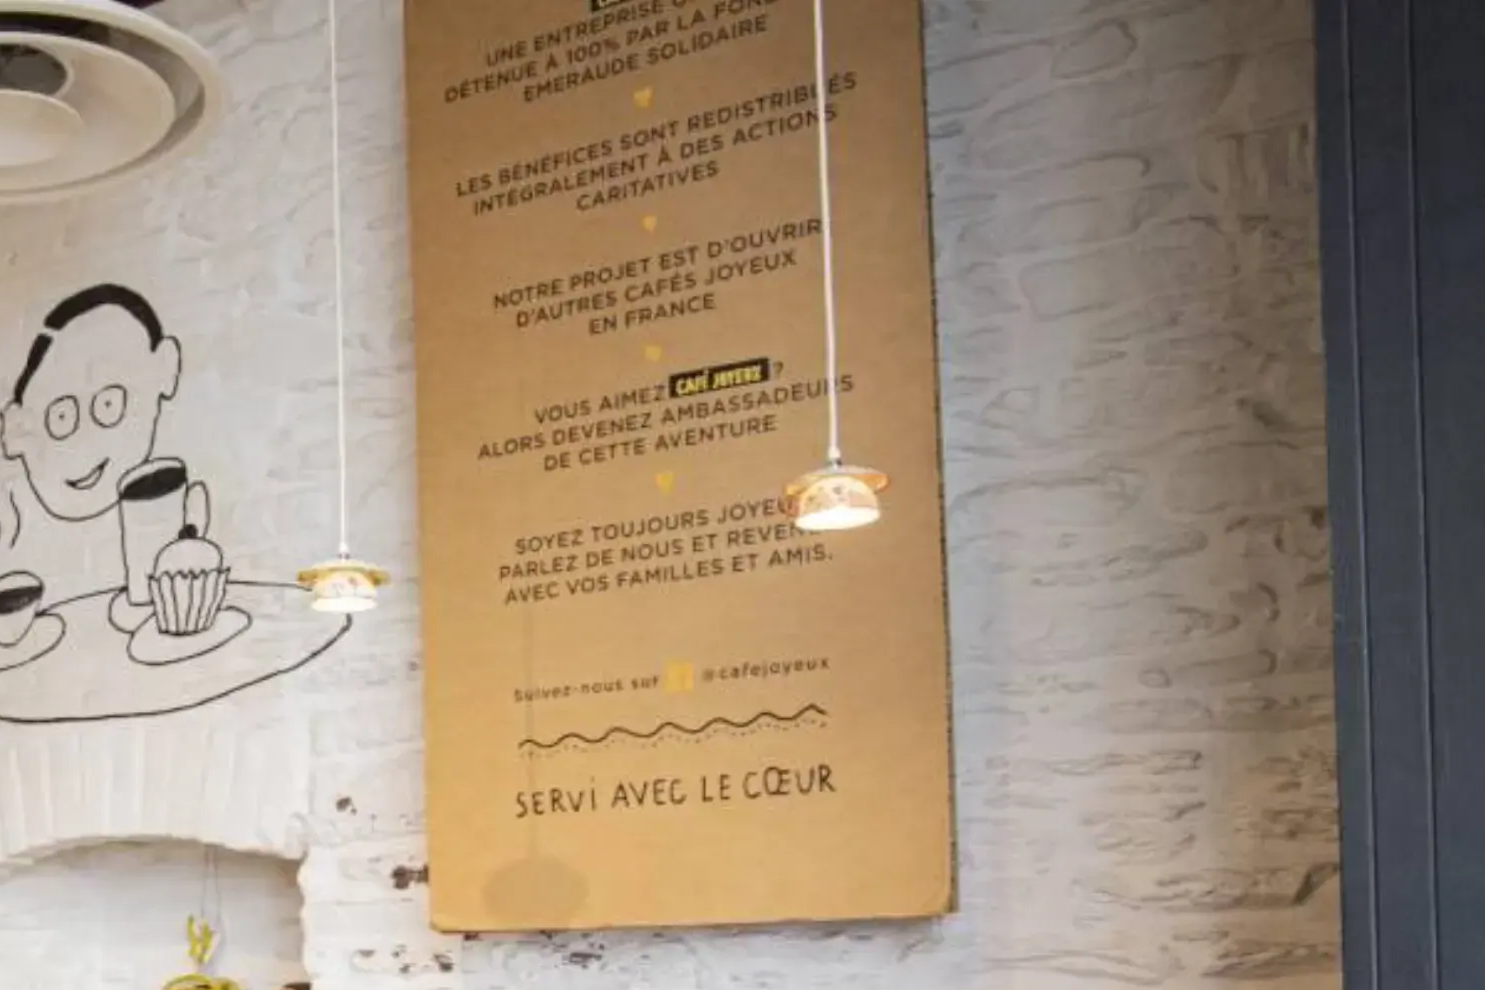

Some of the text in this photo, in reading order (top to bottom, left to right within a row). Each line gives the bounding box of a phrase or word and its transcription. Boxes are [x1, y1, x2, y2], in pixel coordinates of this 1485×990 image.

[487, 0, 665, 67] UNE ENTREPRISE
[626, 20, 670, 46] PAR
[677, 9, 706, 34] LA
[647, 14, 768, 65] SOLIDAIRE
[456, 173, 492, 197] LES
[620, 120, 679, 151] SONT
[680, 134, 724, 160] DES
[733, 103, 838, 145] ACTIONS
[576, 160, 719, 211] CARITATIVES
[493, 279, 564, 309] NOTRE
[570, 257, 651, 291] PROJET
[659, 245, 699, 271] EST
[624, 271, 696, 303] CAFÉS
[705, 248, 797, 286] JOYEUX
[589, 293, 715, 336] EN FRANCE
[534, 400, 591, 424] VOUS
[599, 384, 664, 412] AIMEZ
[478, 432, 545, 460] ALORS
[552, 412, 652, 446] DEVENEZ
[544, 415, 778, 471] DE CETTE AVENTURE
[499, 520, 821, 582] PARLEZ DE NOUS ET REVEN
[515, 497, 794, 555] SOYEZ TOUJOURS JOYEU
[504, 543, 834, 606] AVEC VOS FAMILLES ET AMIS.
[631, 674, 659, 690] sur
[611, 778, 687, 809] AVEC
[701, 773, 731, 803] LE
